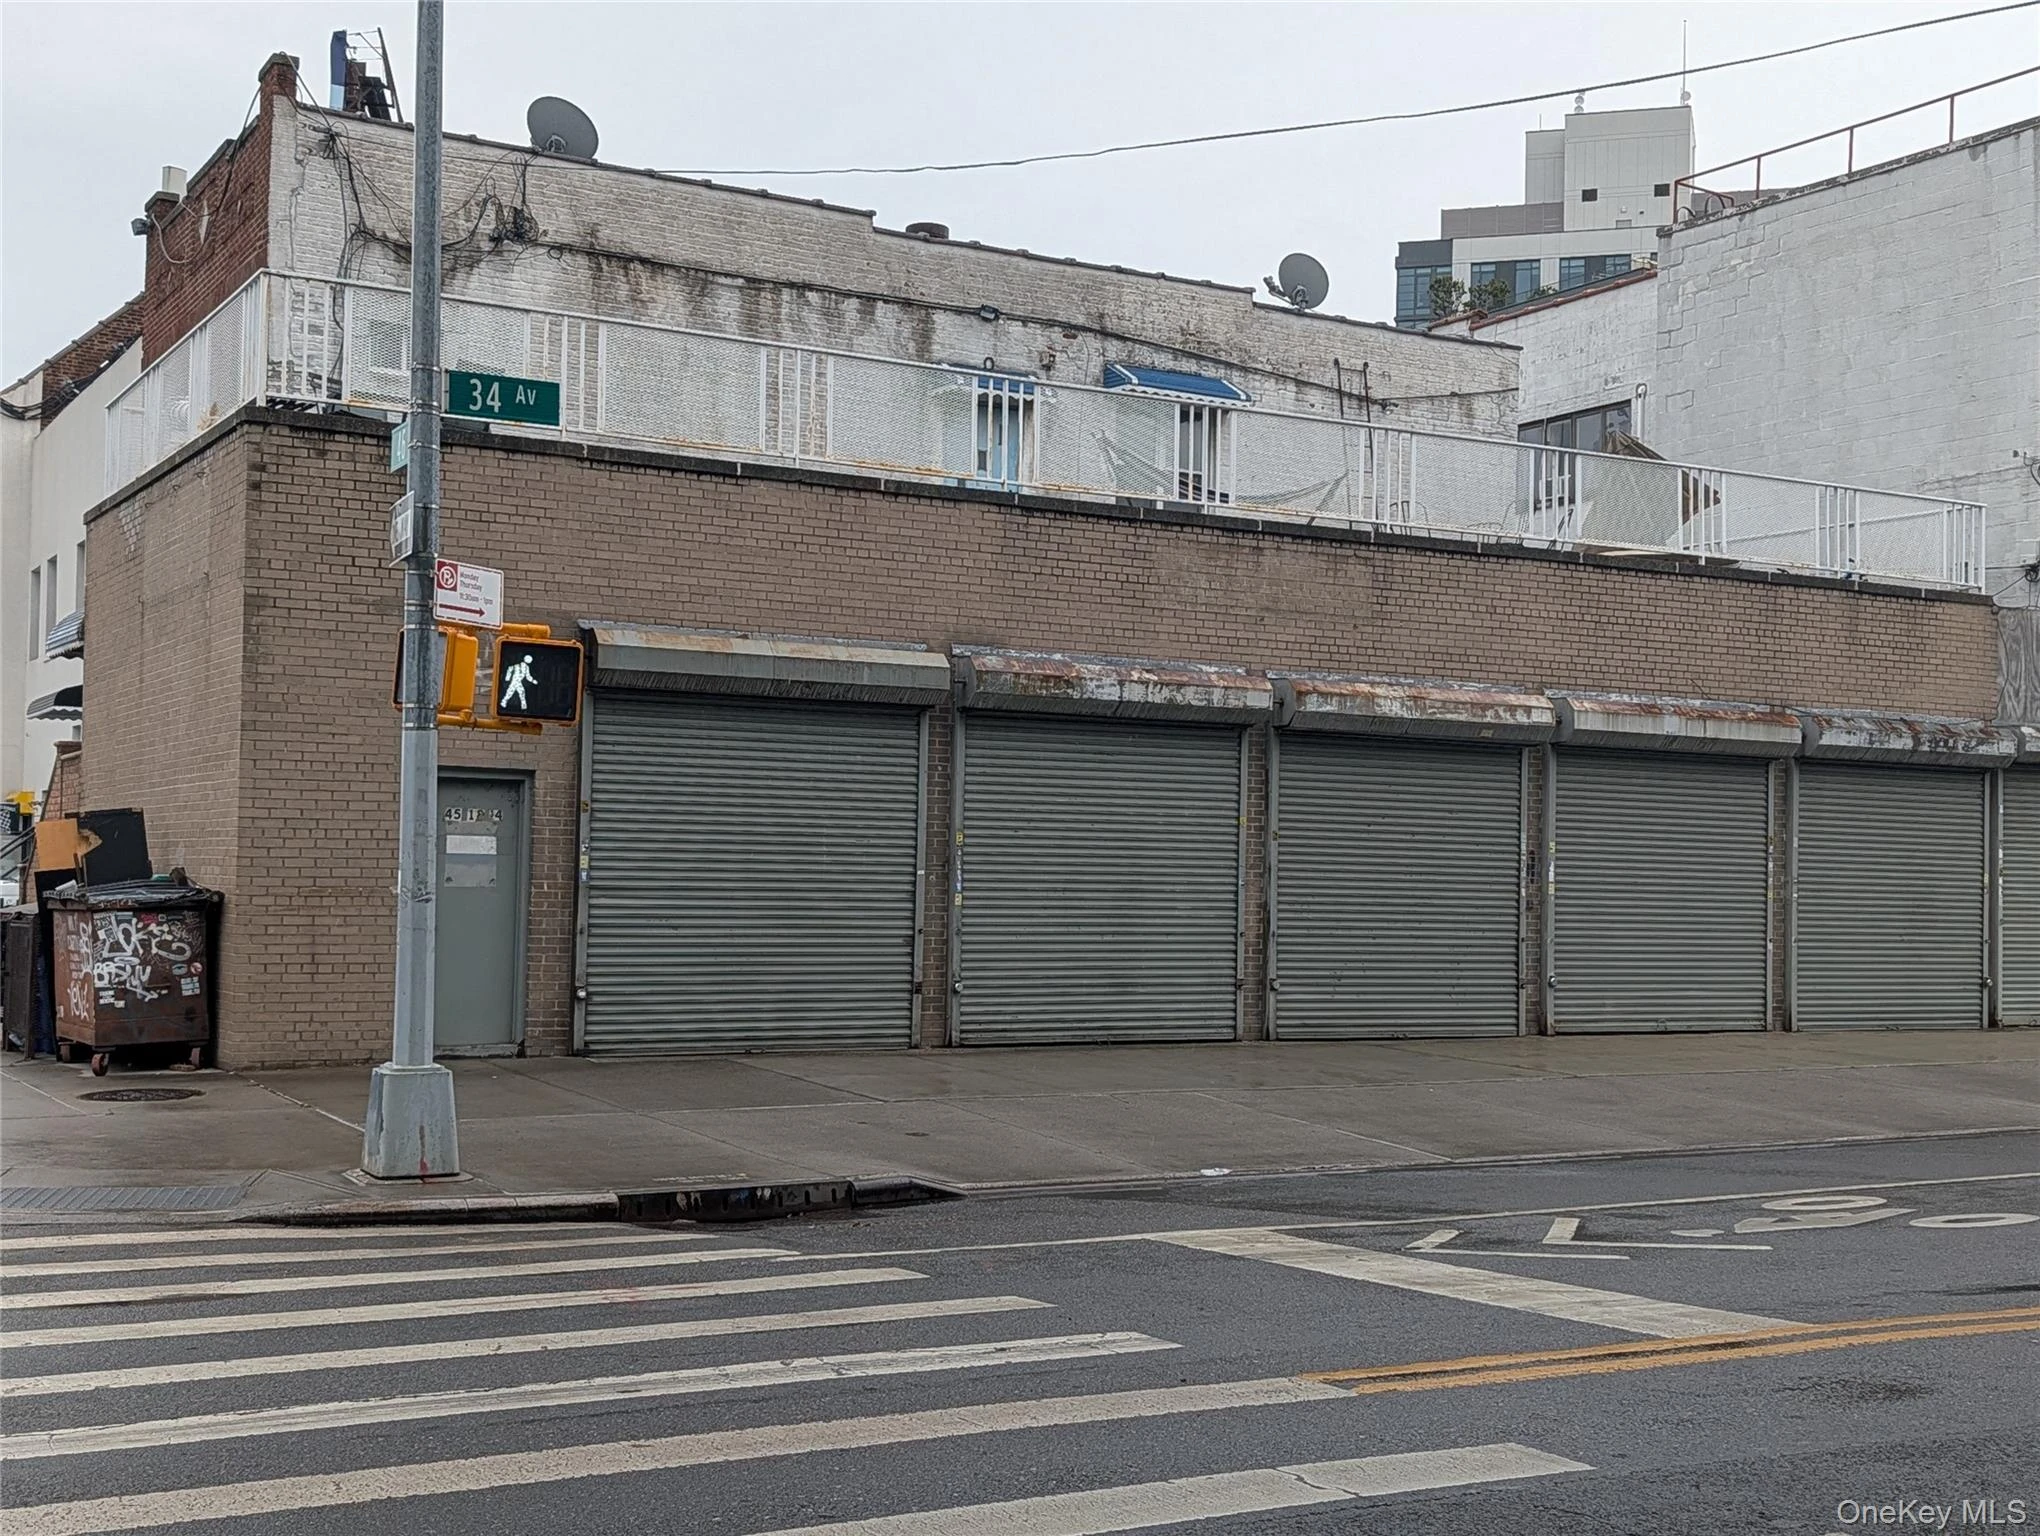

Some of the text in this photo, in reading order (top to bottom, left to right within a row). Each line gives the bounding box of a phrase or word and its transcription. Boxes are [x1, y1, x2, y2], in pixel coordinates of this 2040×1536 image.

[469, 378, 501, 413] 34
[460, 572, 479, 583] Monday
[460, 580, 482, 592] Thursday
[445, 809, 461, 820] 45
